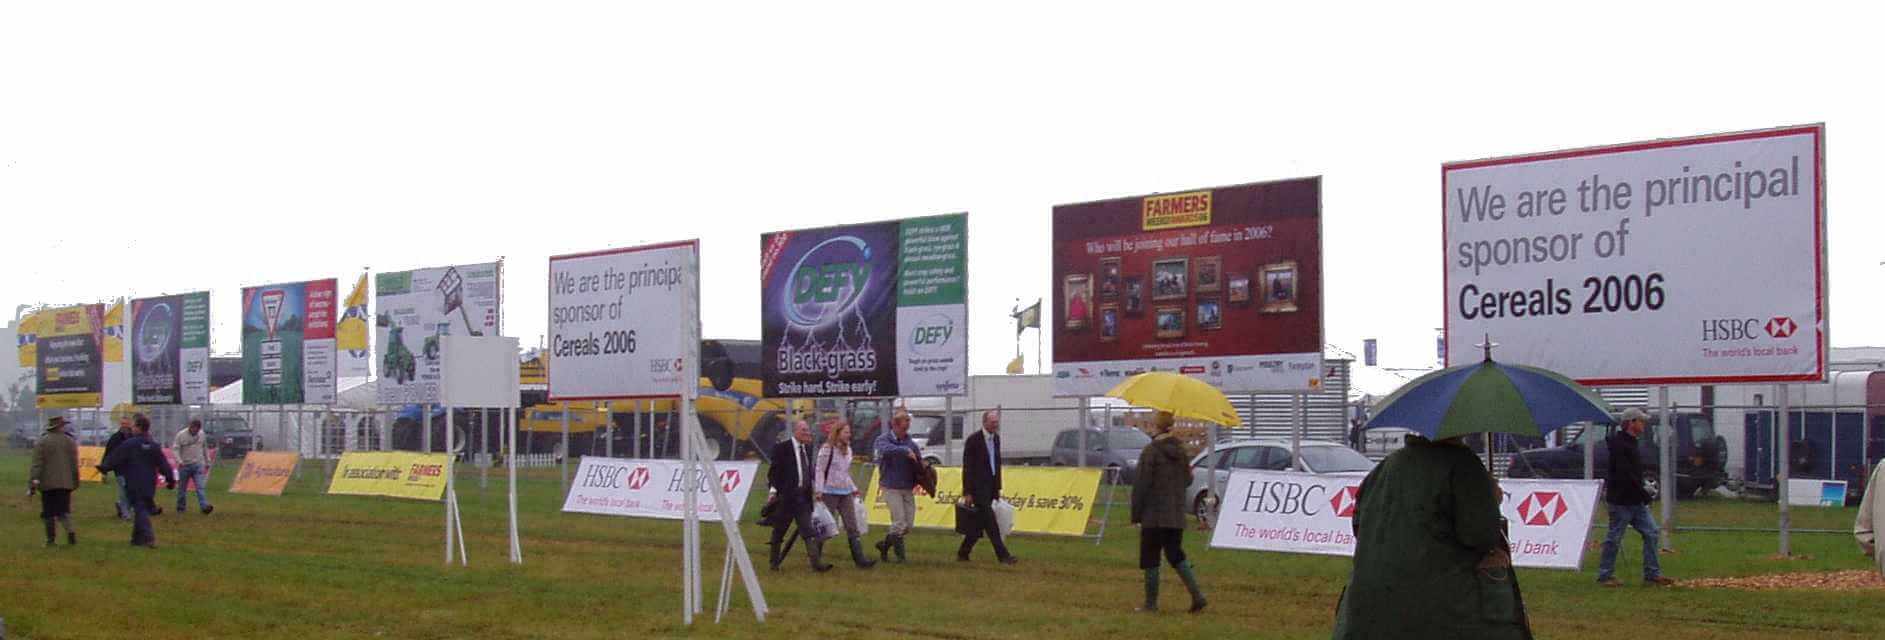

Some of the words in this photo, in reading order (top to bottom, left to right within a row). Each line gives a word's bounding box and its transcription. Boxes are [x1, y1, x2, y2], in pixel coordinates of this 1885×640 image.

[1457, 185, 1506, 222] We
[1517, 186, 1566, 219] are
[1577, 174, 1632, 213] the
[1645, 155, 1800, 217] principal
[1146, 194, 1208, 217] FARMERS
[1087, 241, 1104, 254] Who
[1123, 238, 1134, 252] be
[1198, 230, 1210, 244] of
[1210, 230, 1232, 244] fame
[1233, 228, 1243, 240] in
[1244, 225, 1272, 240] 2006?
[1458, 232, 1583, 276] sponsor
[1594, 218, 1630, 258] of
[555, 271, 575, 295] We
[579, 273, 599, 293] are
[604, 266, 625, 291] the
[629, 259, 681, 295] principa
[794, 262, 873, 305] DEFY
[1459, 278, 1572, 321] Cereals
[1583, 272, 1665, 314] 2006
[554, 302, 606, 329] sponsor
[608, 294, 624, 321] of
[914, 326, 953, 346] DEFY
[1702, 318, 1760, 341] HSBC
[553, 332, 600, 357] Cereals
[604, 330, 636, 355] 2006
[1702, 347, 1719, 358] The
[1720, 346, 1751, 358] world's
[1753, 346, 1774, 357] local
[1776, 345, 1798, 356] bank
[650, 358, 673, 372] HSBC
[777, 346, 877, 378] Black-grass
[778, 380, 801, 394] Strike
[825, 379, 850, 393] Strike
[582, 464, 628, 489] HSBC
[1036, 497, 1057, 509] save
[1058, 495, 1084, 511] 30%
[1242, 480, 1325, 516] HSBC
[1235, 523, 1256, 538] The
[1260, 526, 1300, 542] world's
[1303, 528, 1332, 543] local
[1523, 540, 1559, 555] bank
